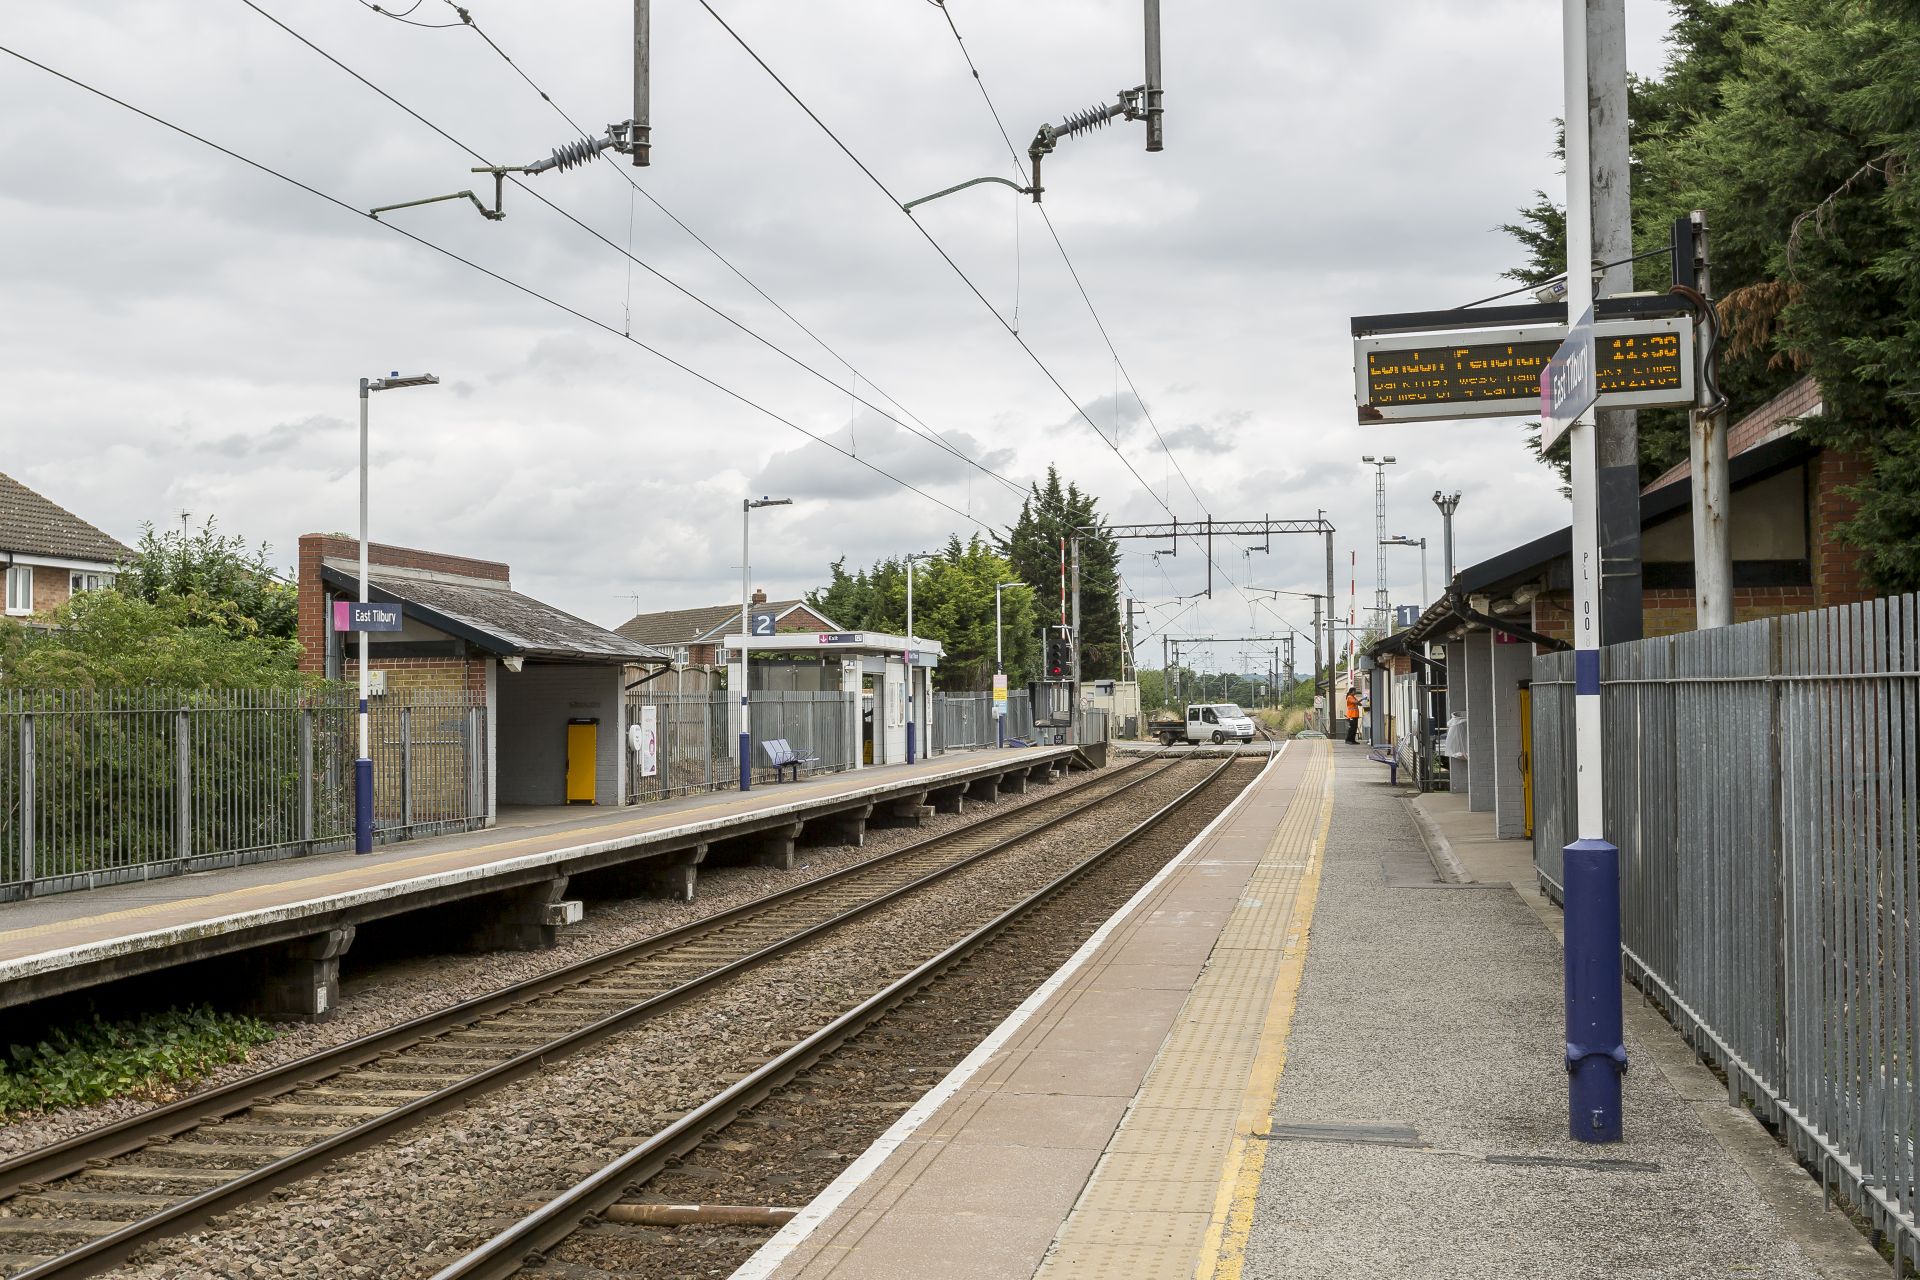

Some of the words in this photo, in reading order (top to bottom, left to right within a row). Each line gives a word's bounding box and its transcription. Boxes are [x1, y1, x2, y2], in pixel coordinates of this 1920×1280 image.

[1553, 365, 1567, 411] East
[1567, 341, 1588, 394] Tilbury
[355, 609, 371, 622] East
[372, 609, 396, 625] Tilbury
[756, 615, 771, 634] 2
[1403, 607, 1411, 625] 1
